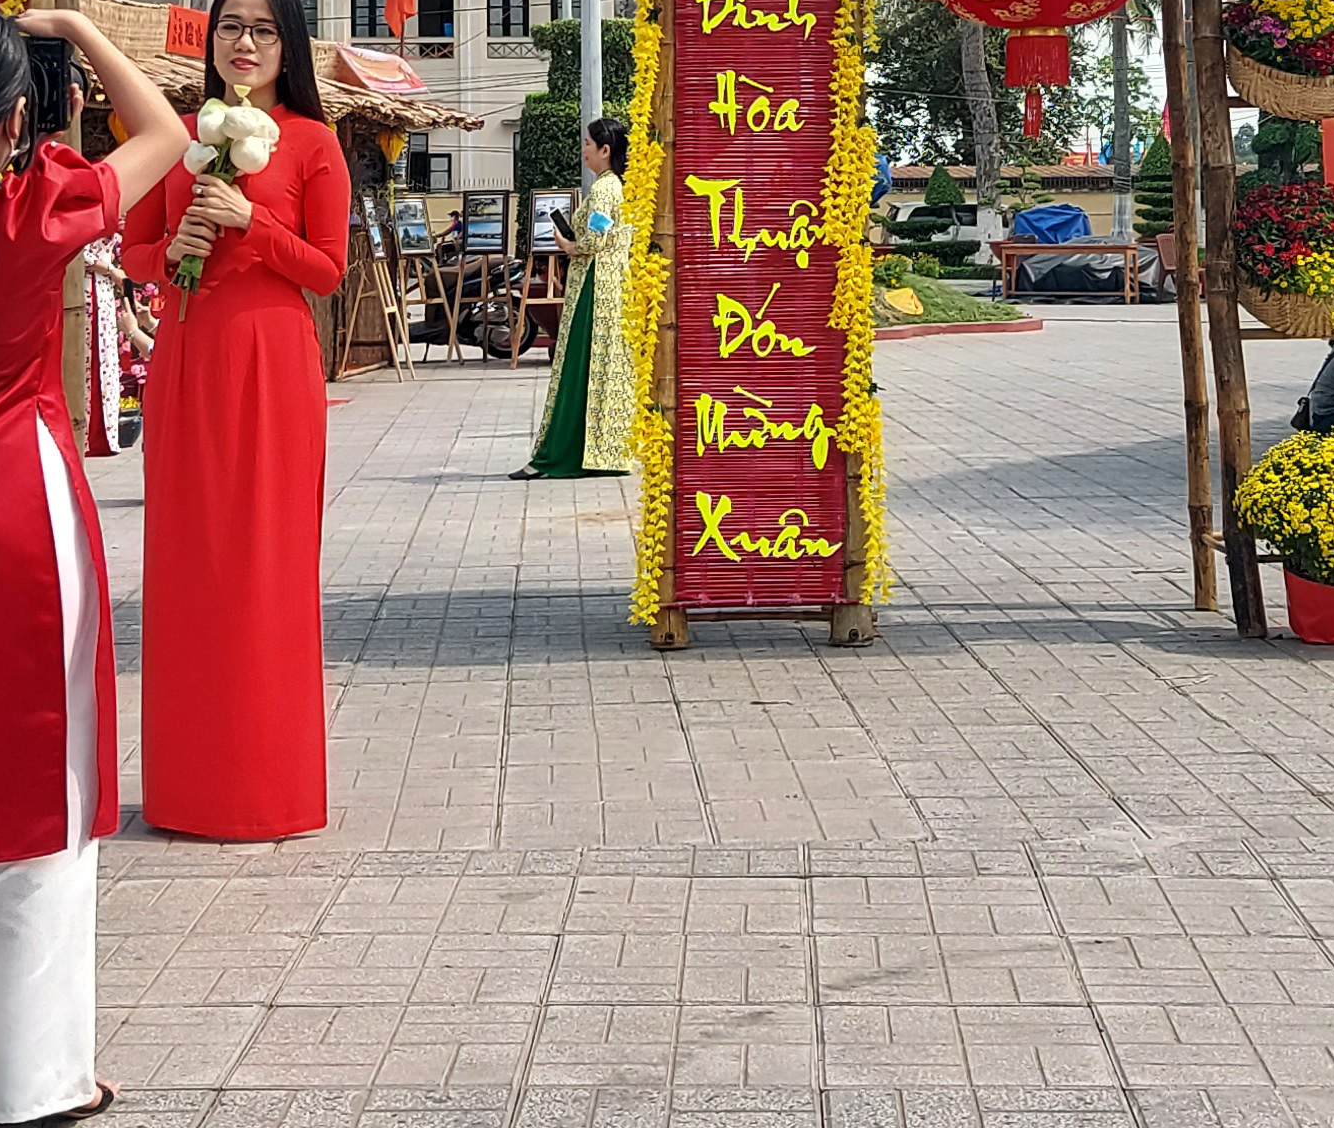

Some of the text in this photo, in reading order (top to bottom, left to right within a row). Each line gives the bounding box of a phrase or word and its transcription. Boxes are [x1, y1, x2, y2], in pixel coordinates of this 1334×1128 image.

[709, 70, 805, 135] Hòa
[712, 282, 817, 358] Đón
[694, 385, 837, 470] Mừng
[692, 491, 843, 562] Xuân
